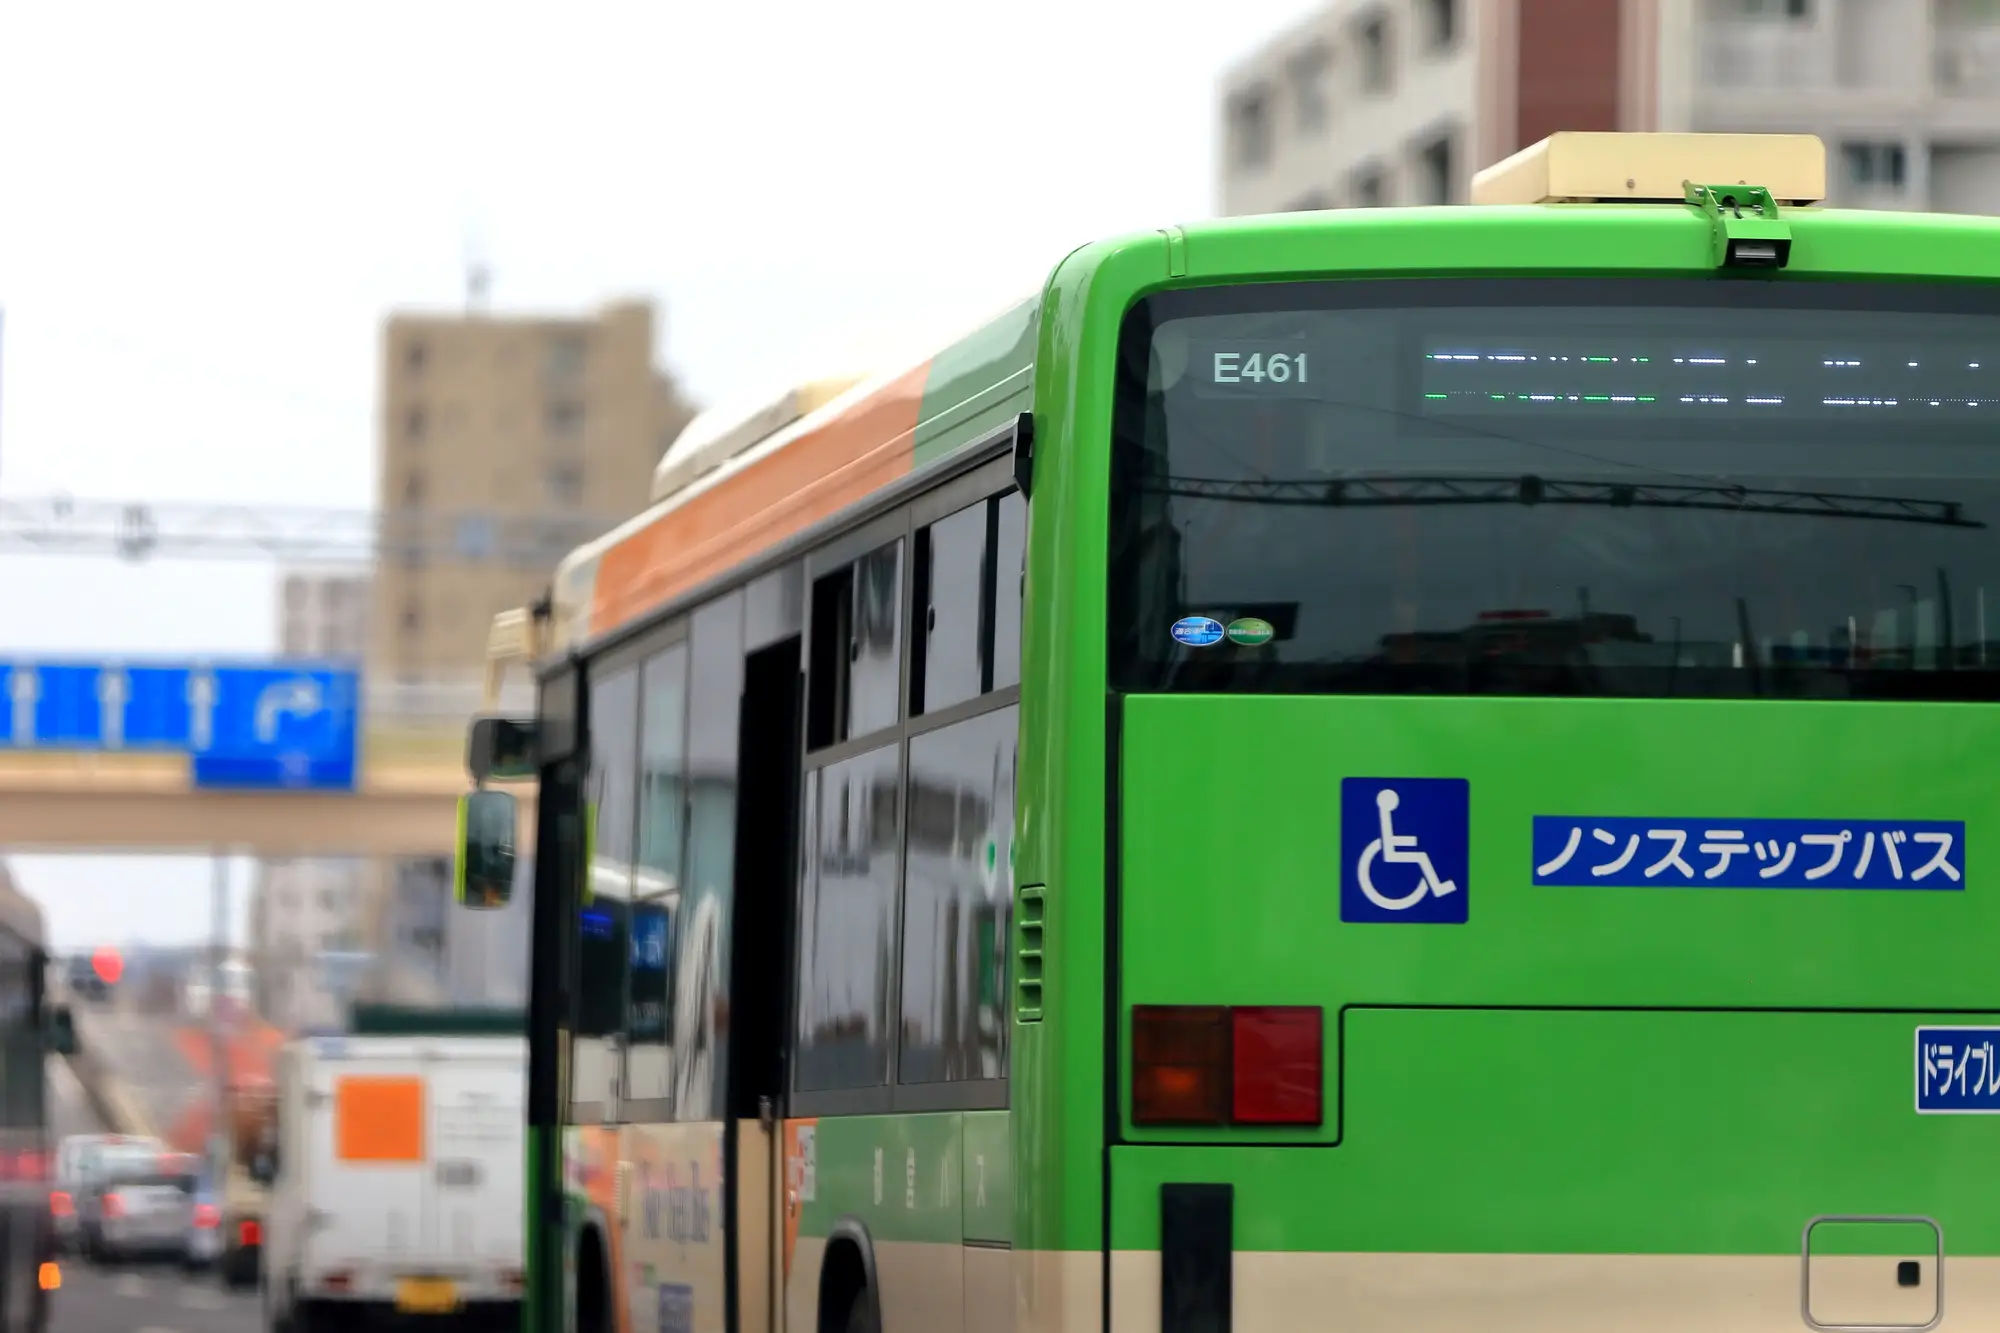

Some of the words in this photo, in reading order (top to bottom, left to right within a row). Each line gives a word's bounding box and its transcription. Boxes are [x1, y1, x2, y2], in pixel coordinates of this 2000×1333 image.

[1214, 352, 1307, 383] E461
[1536, 826, 1961, 882] ノンステップバス
[1923, 1040, 2000, 1097] ドライブレ
